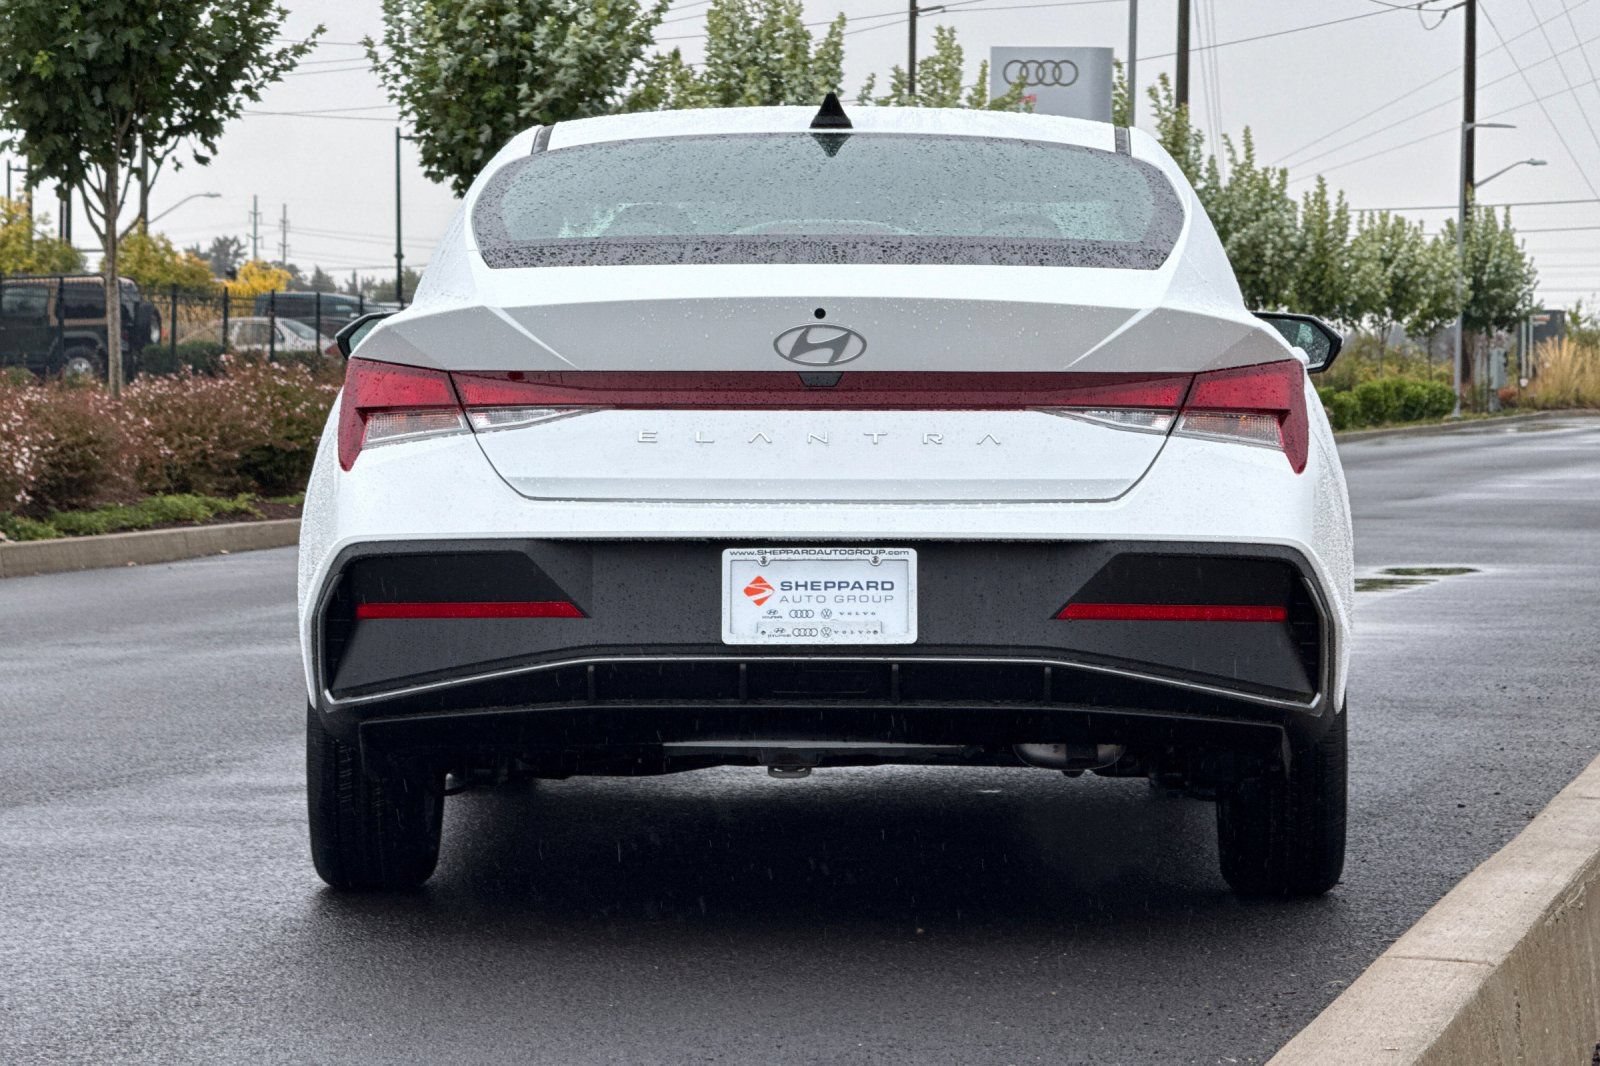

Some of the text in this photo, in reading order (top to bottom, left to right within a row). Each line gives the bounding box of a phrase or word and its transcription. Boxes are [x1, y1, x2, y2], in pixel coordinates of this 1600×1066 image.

[637, 430, 1001, 444] ELANTRA
[780, 580, 894, 591] SHEPPARD
[780, 595, 894, 604] AUTO GROUP
